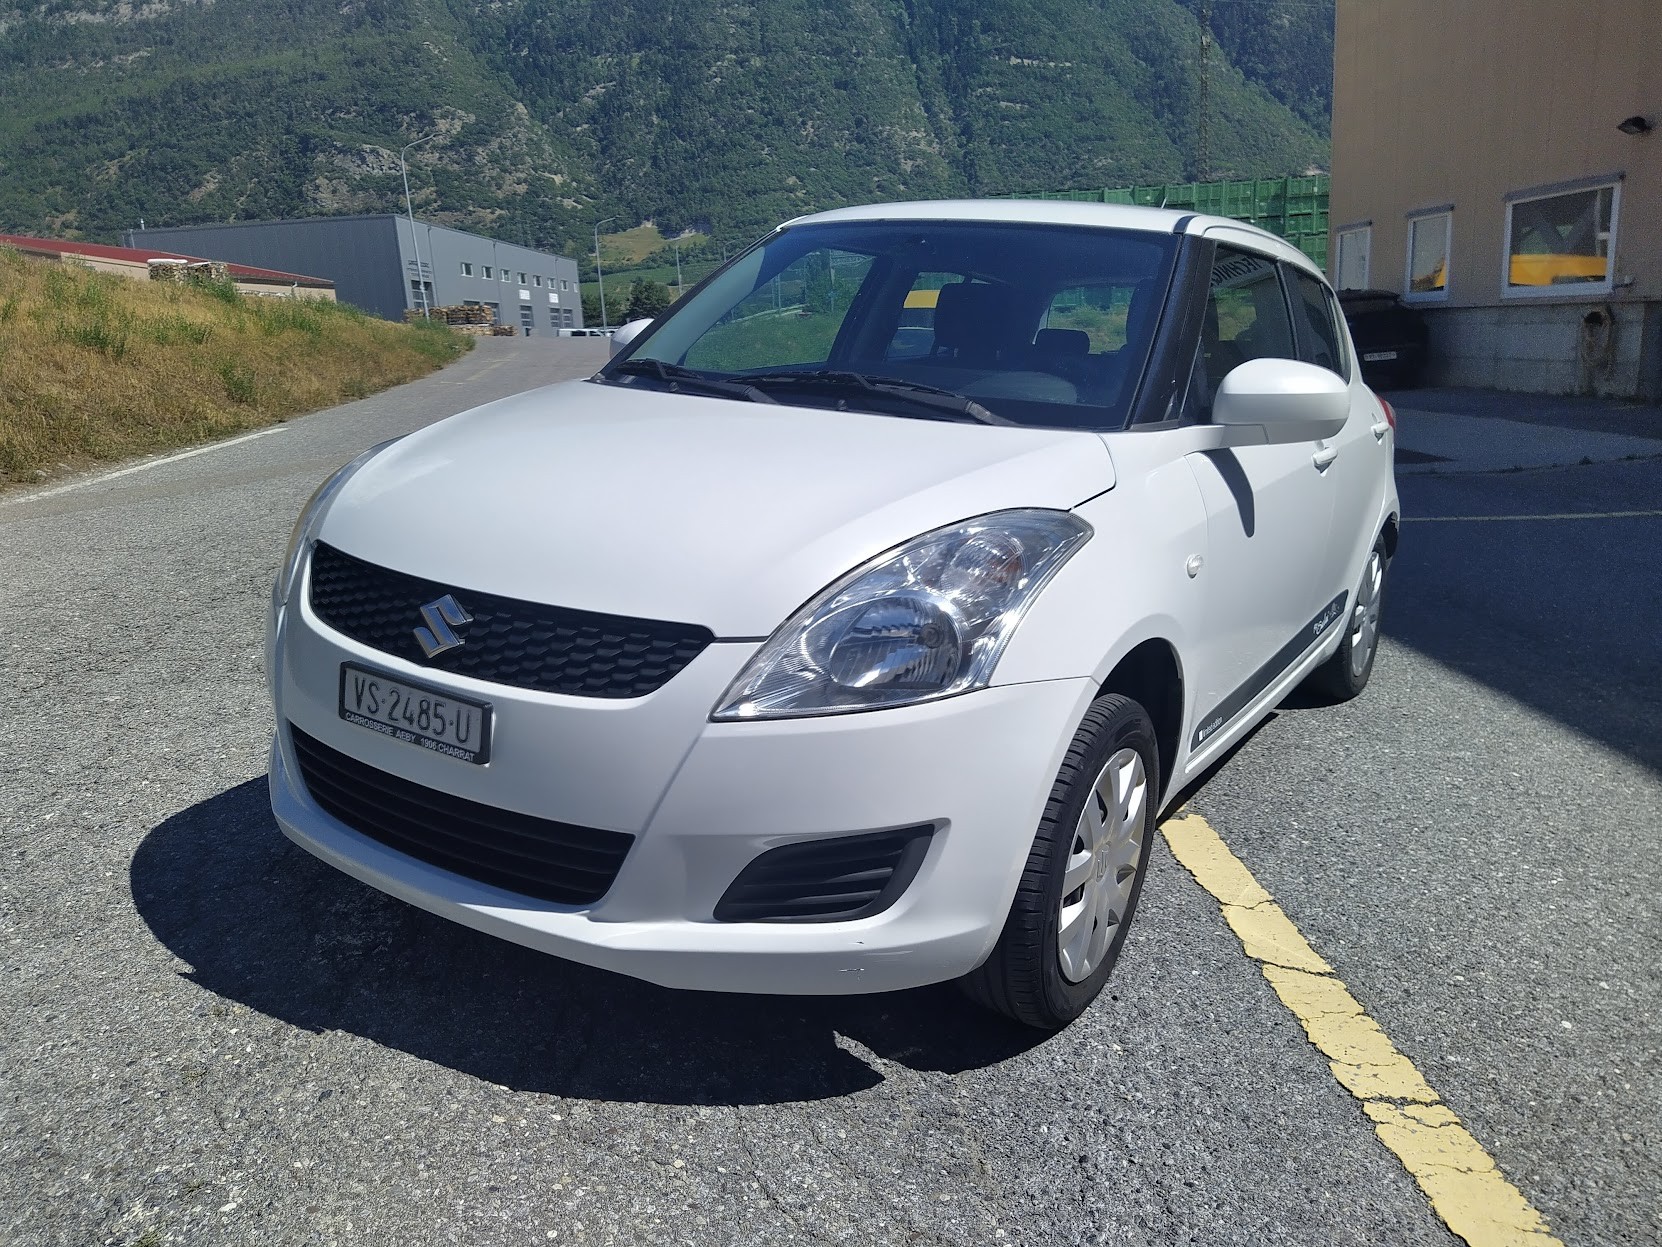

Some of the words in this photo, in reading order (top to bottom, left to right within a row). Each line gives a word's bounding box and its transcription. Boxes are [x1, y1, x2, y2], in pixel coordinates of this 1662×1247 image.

[345, 712, 394, 737] CARROSSERIE
[395, 729, 416, 743] AEBY
[420, 737, 437, 751] 1906
[438, 743, 475, 762] CHARRAT
